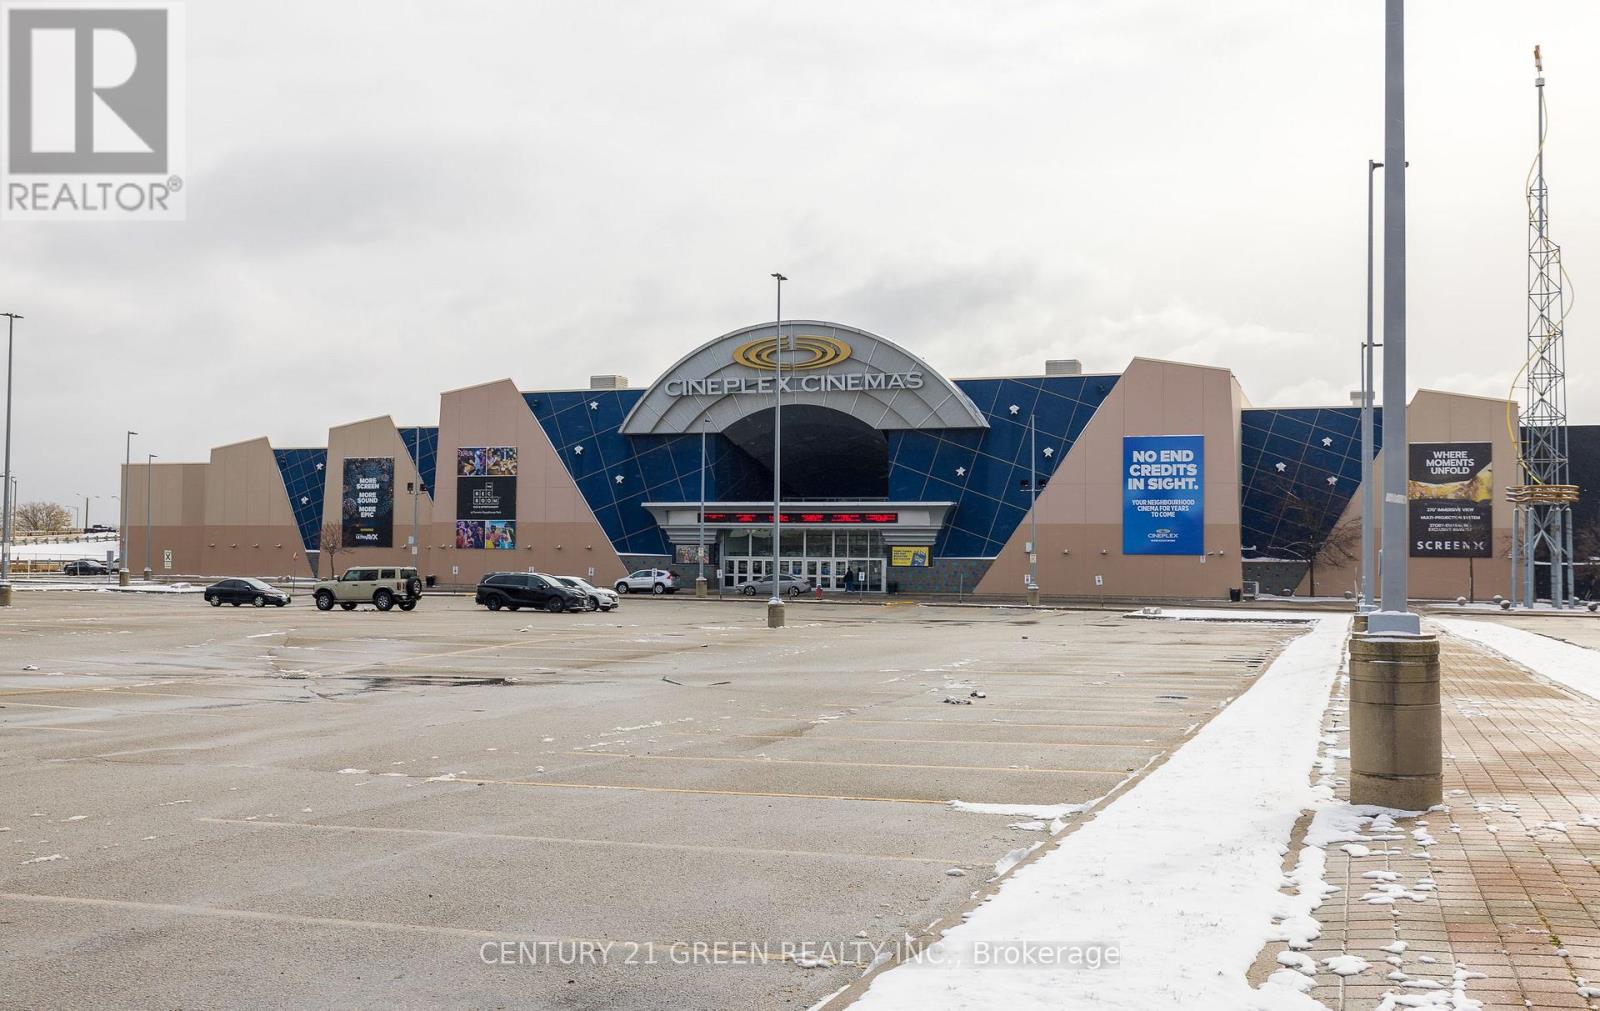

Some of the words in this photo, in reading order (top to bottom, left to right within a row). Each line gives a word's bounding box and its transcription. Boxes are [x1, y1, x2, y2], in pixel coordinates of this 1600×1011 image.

[664, 376, 794, 397] CINEPLEX
[801, 371, 925, 393] CINEMAS
[1132, 450, 1158, 462] NO
[1160, 450, 1194, 462] END
[1432, 451, 1468, 459] WHERE
[1425, 459, 1475, 467] MOMENTS
[1129, 464, 1198, 476] CREDITS
[1430, 467, 1470, 475] UNFOLD
[1128, 478, 1145, 490] IN
[1147, 477, 1199, 490] SIGHT.
